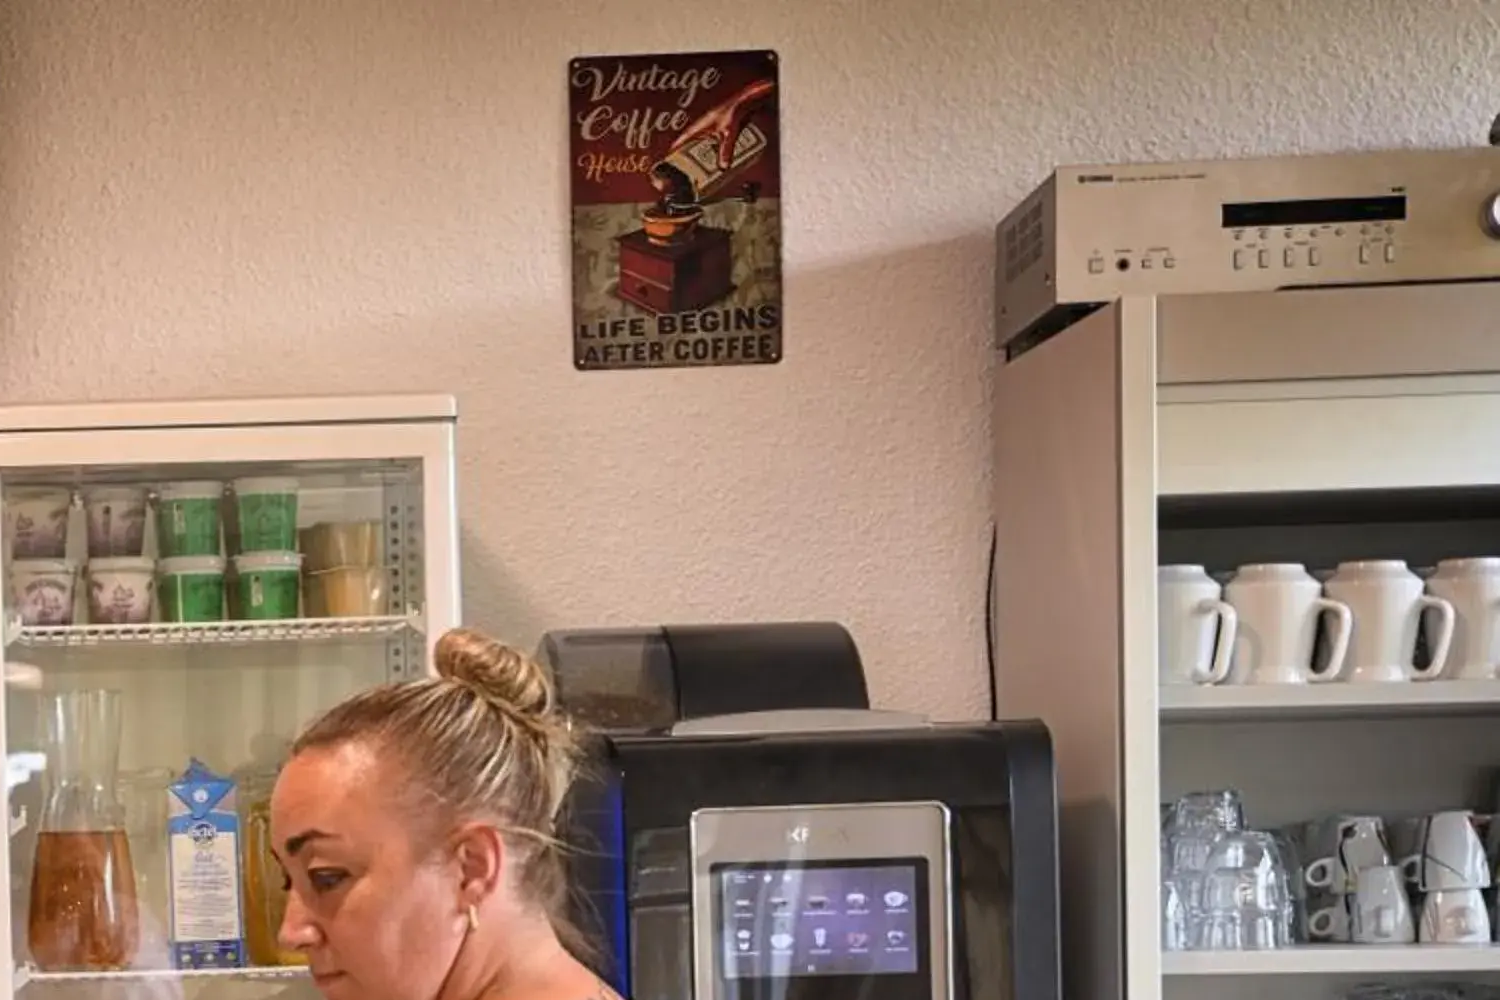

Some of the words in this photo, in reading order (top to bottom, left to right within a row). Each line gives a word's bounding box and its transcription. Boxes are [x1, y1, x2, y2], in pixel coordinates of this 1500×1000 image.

[572, 62, 722, 108] Vintage
[578, 105, 690, 149] Coffee
[577, 152, 651, 183] House
[580, 317, 646, 340] LIFE
[657, 305, 780, 335] BEGINS
[584, 341, 664, 363] AFTER
[673, 335, 775, 361] COFFEE
